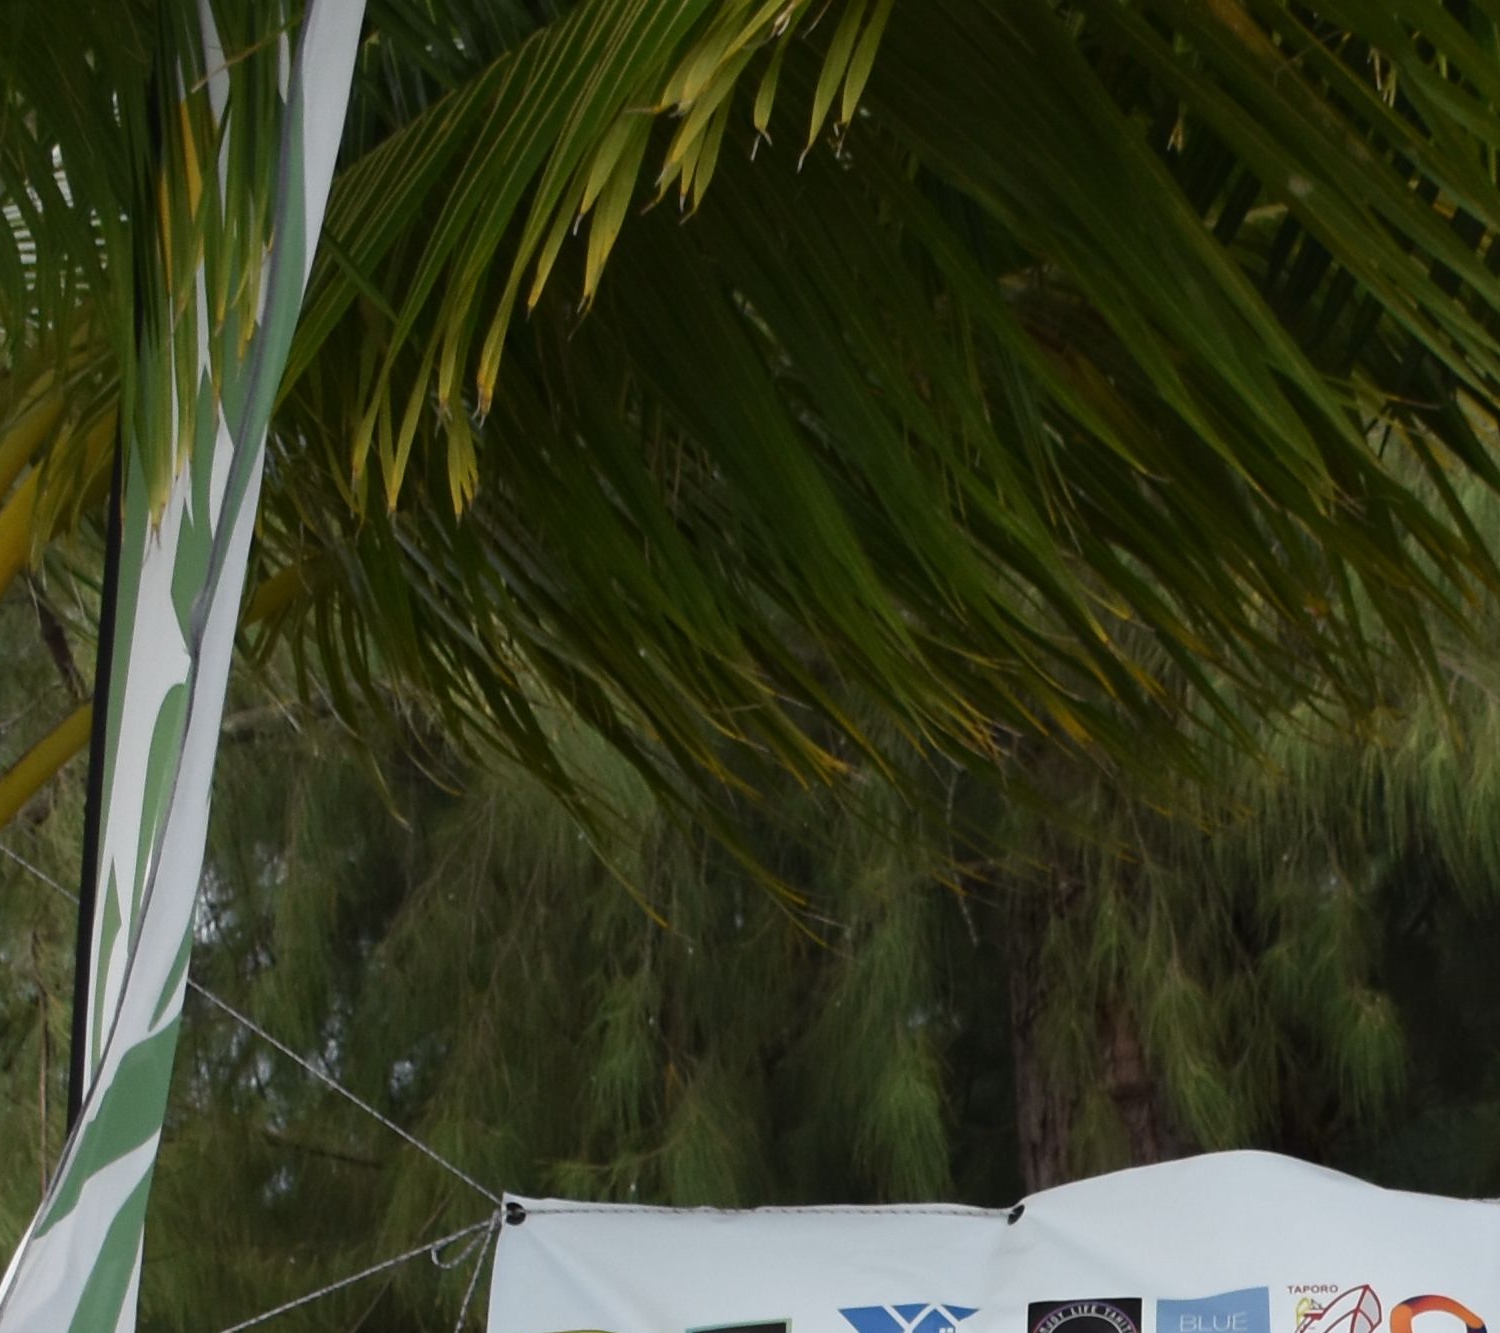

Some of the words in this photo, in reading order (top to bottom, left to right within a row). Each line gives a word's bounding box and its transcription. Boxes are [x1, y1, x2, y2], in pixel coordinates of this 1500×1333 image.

[1287, 1284, 1339, 1295] TAPORO
[1071, 1304, 1101, 1317] LIFE
[1180, 1312, 1248, 1333] BLUE
